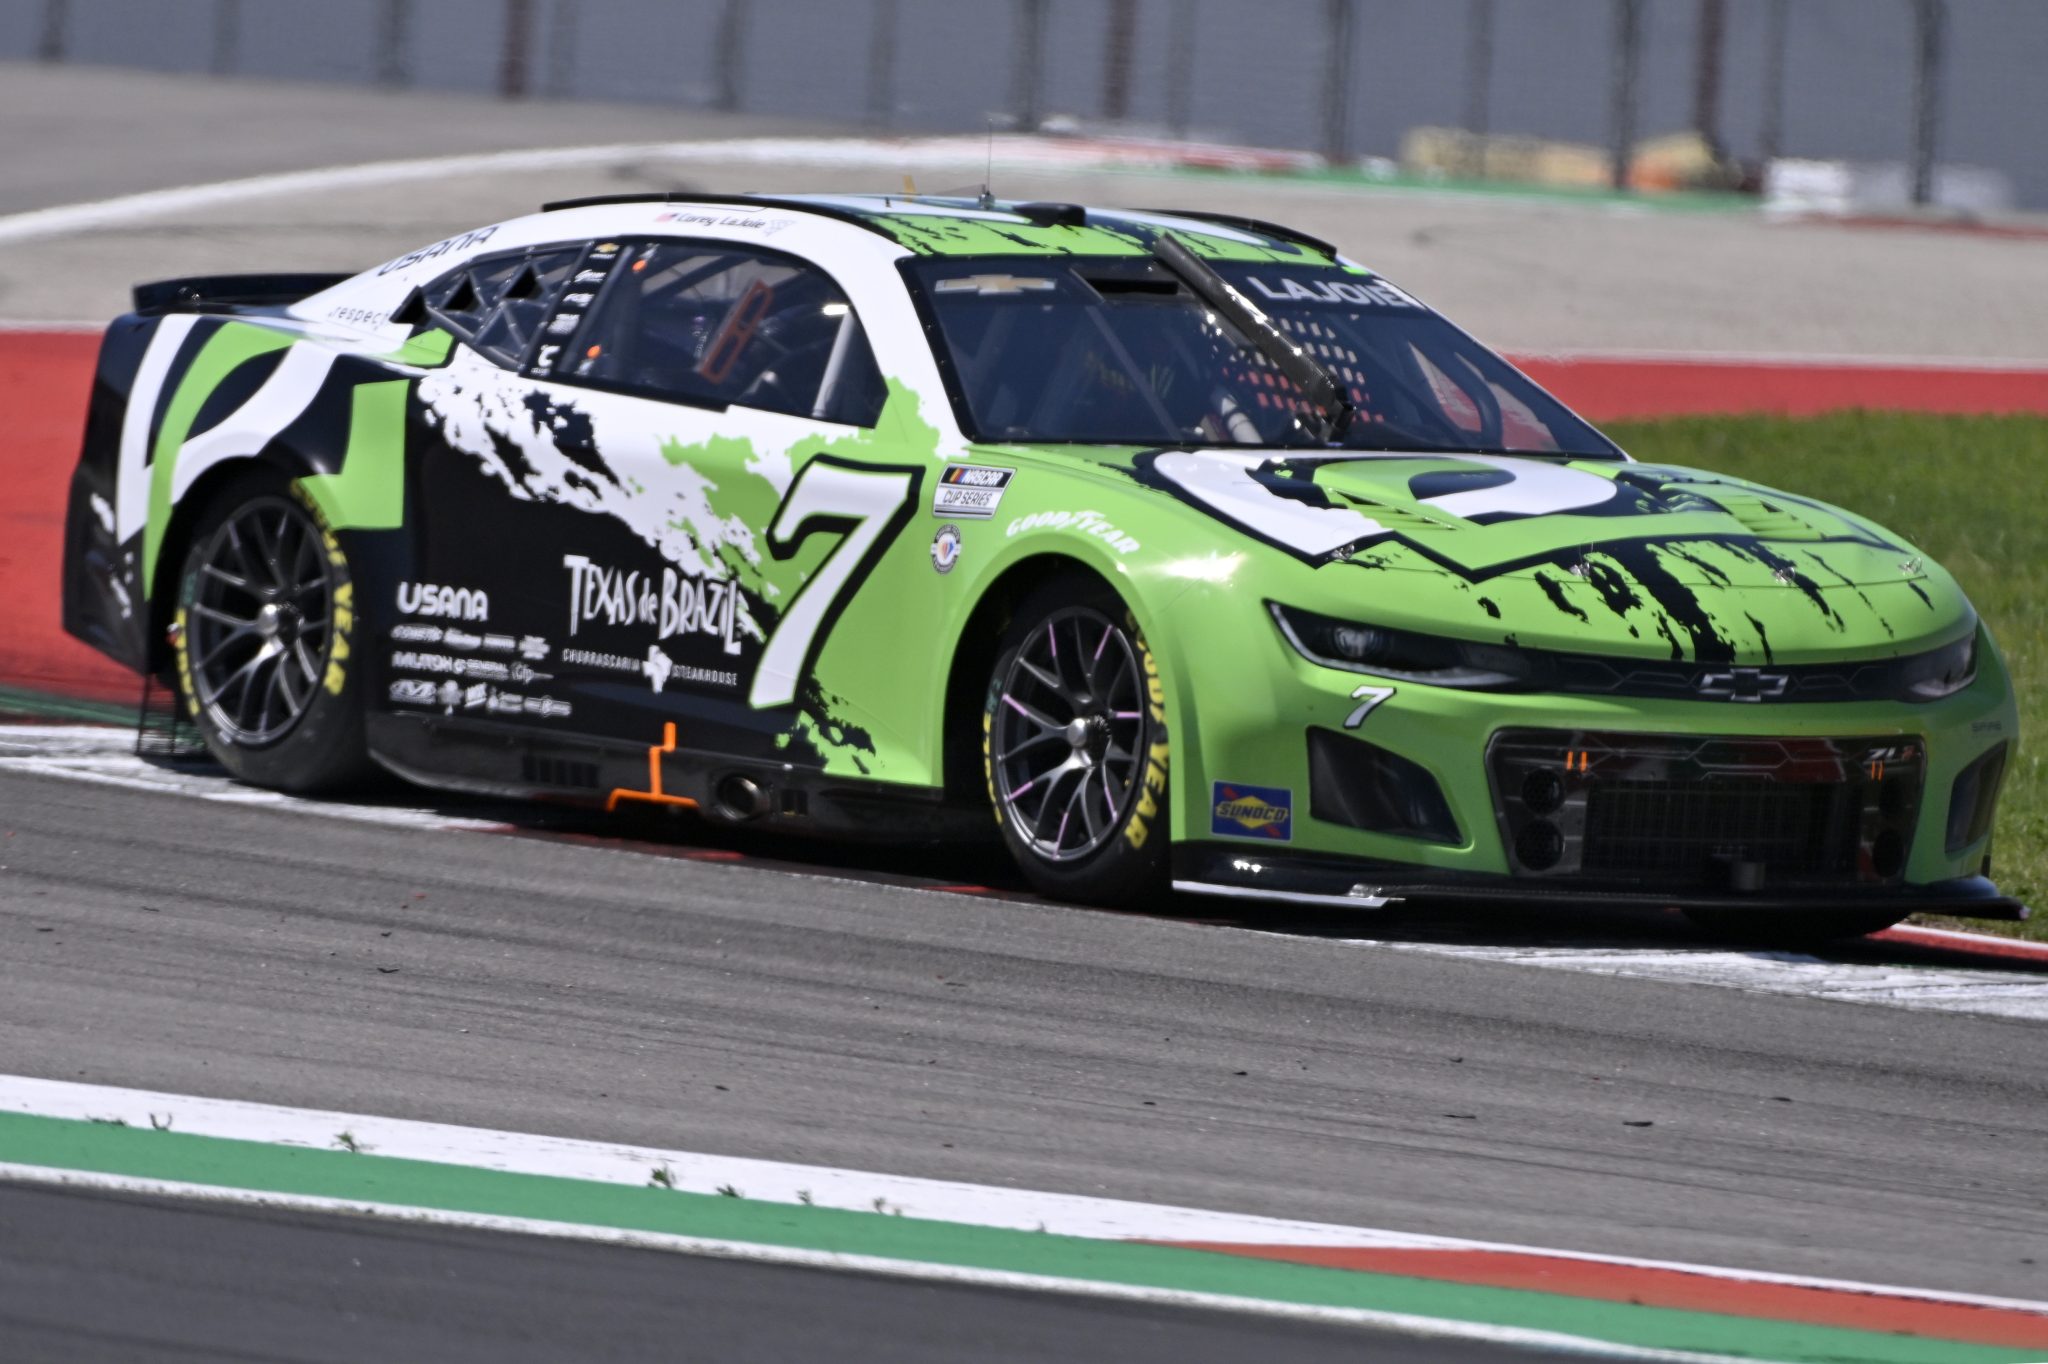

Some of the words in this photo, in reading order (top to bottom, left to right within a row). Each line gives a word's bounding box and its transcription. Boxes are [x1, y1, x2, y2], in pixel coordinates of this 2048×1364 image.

[378, 225, 500, 277] USANA
[1246, 276, 1411, 308] LAJOIE
[961, 469, 1004, 487] NASCAR
[943, 489, 962, 504] CUP
[960, 490, 992, 506] SERIES
[751, 454, 924, 709] 7
[397, 581, 489, 623] USANA
[563, 554, 640, 636] TEXAS
[638, 577, 658, 625] de
[658, 567, 742, 656] BRAZIL
[671, 663, 738, 686] STEAKHOUSE
[1344, 684, 1397, 730] 7
[1217, 802, 1290, 823] SUNOCO
